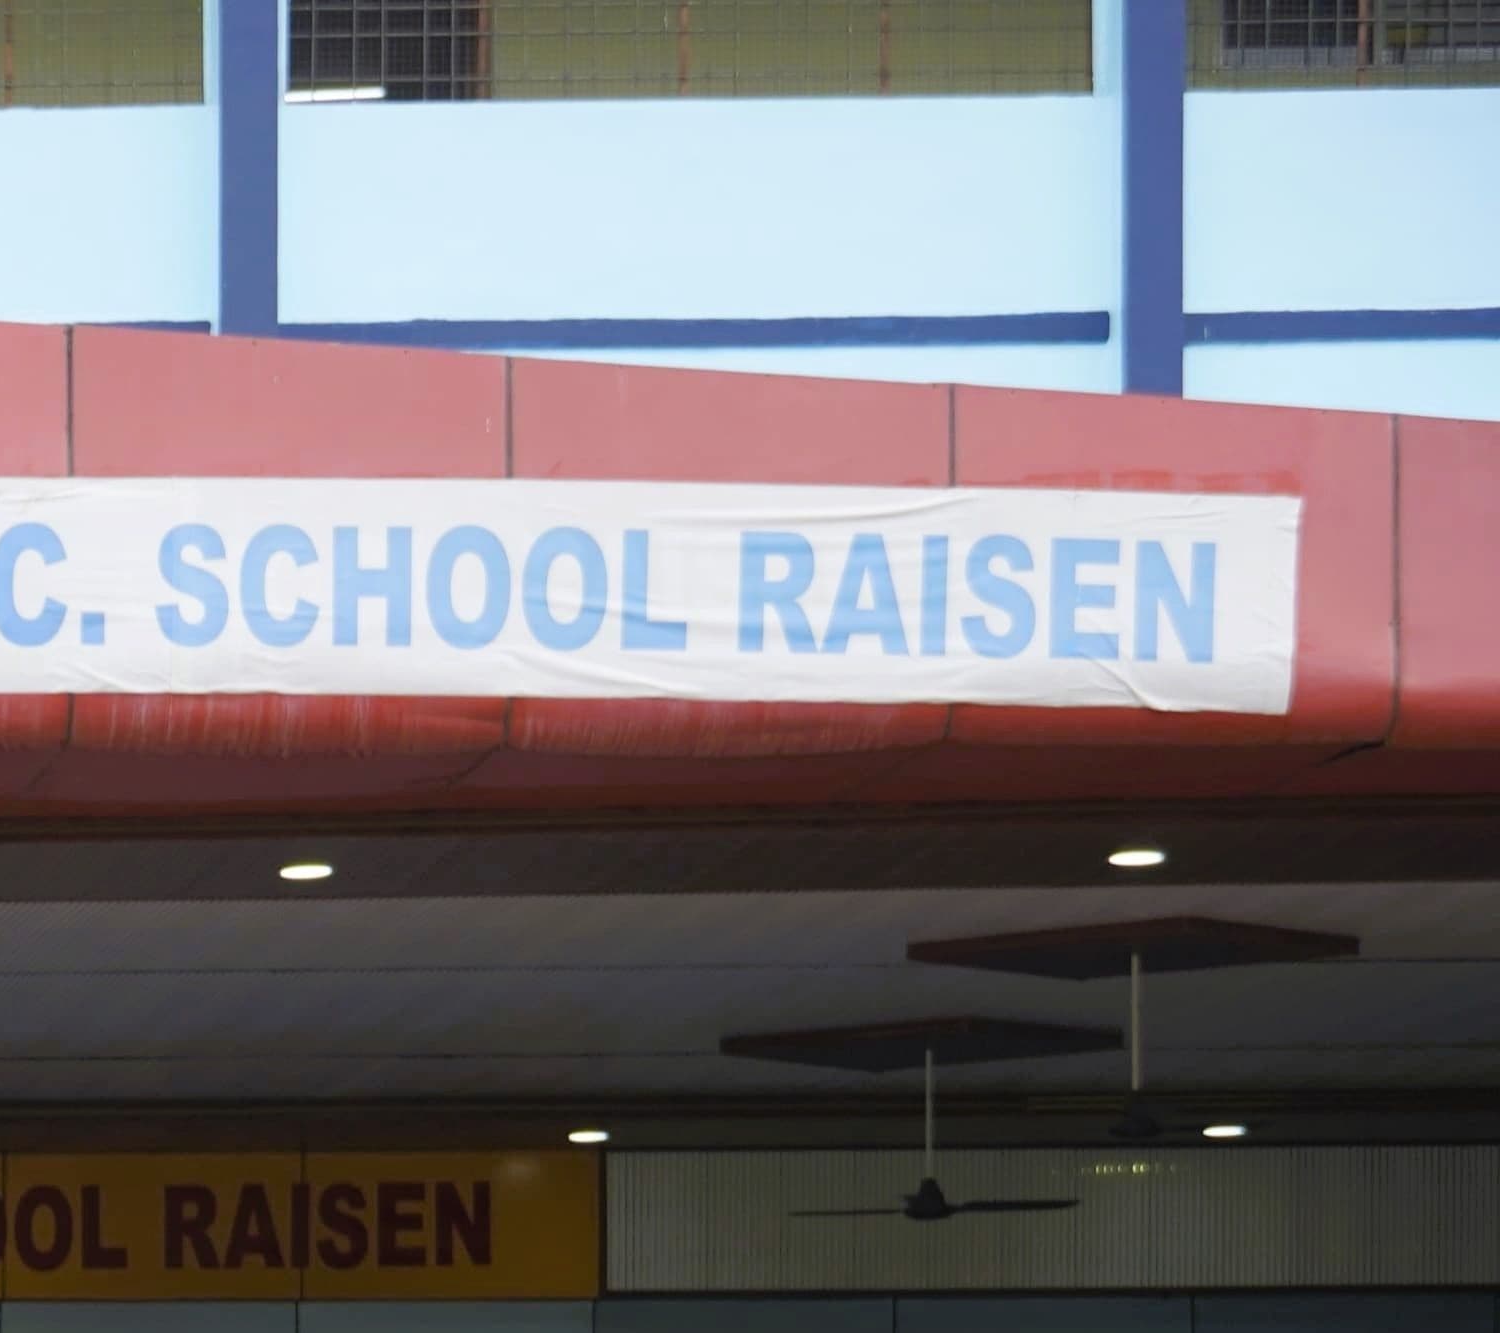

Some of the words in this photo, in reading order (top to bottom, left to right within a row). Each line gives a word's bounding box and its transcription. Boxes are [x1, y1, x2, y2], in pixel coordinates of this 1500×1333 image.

[157, 525, 687, 652] SCHOOL
[739, 532, 1217, 664] RAISEN
[163, 1179, 494, 1268] RAISEN
